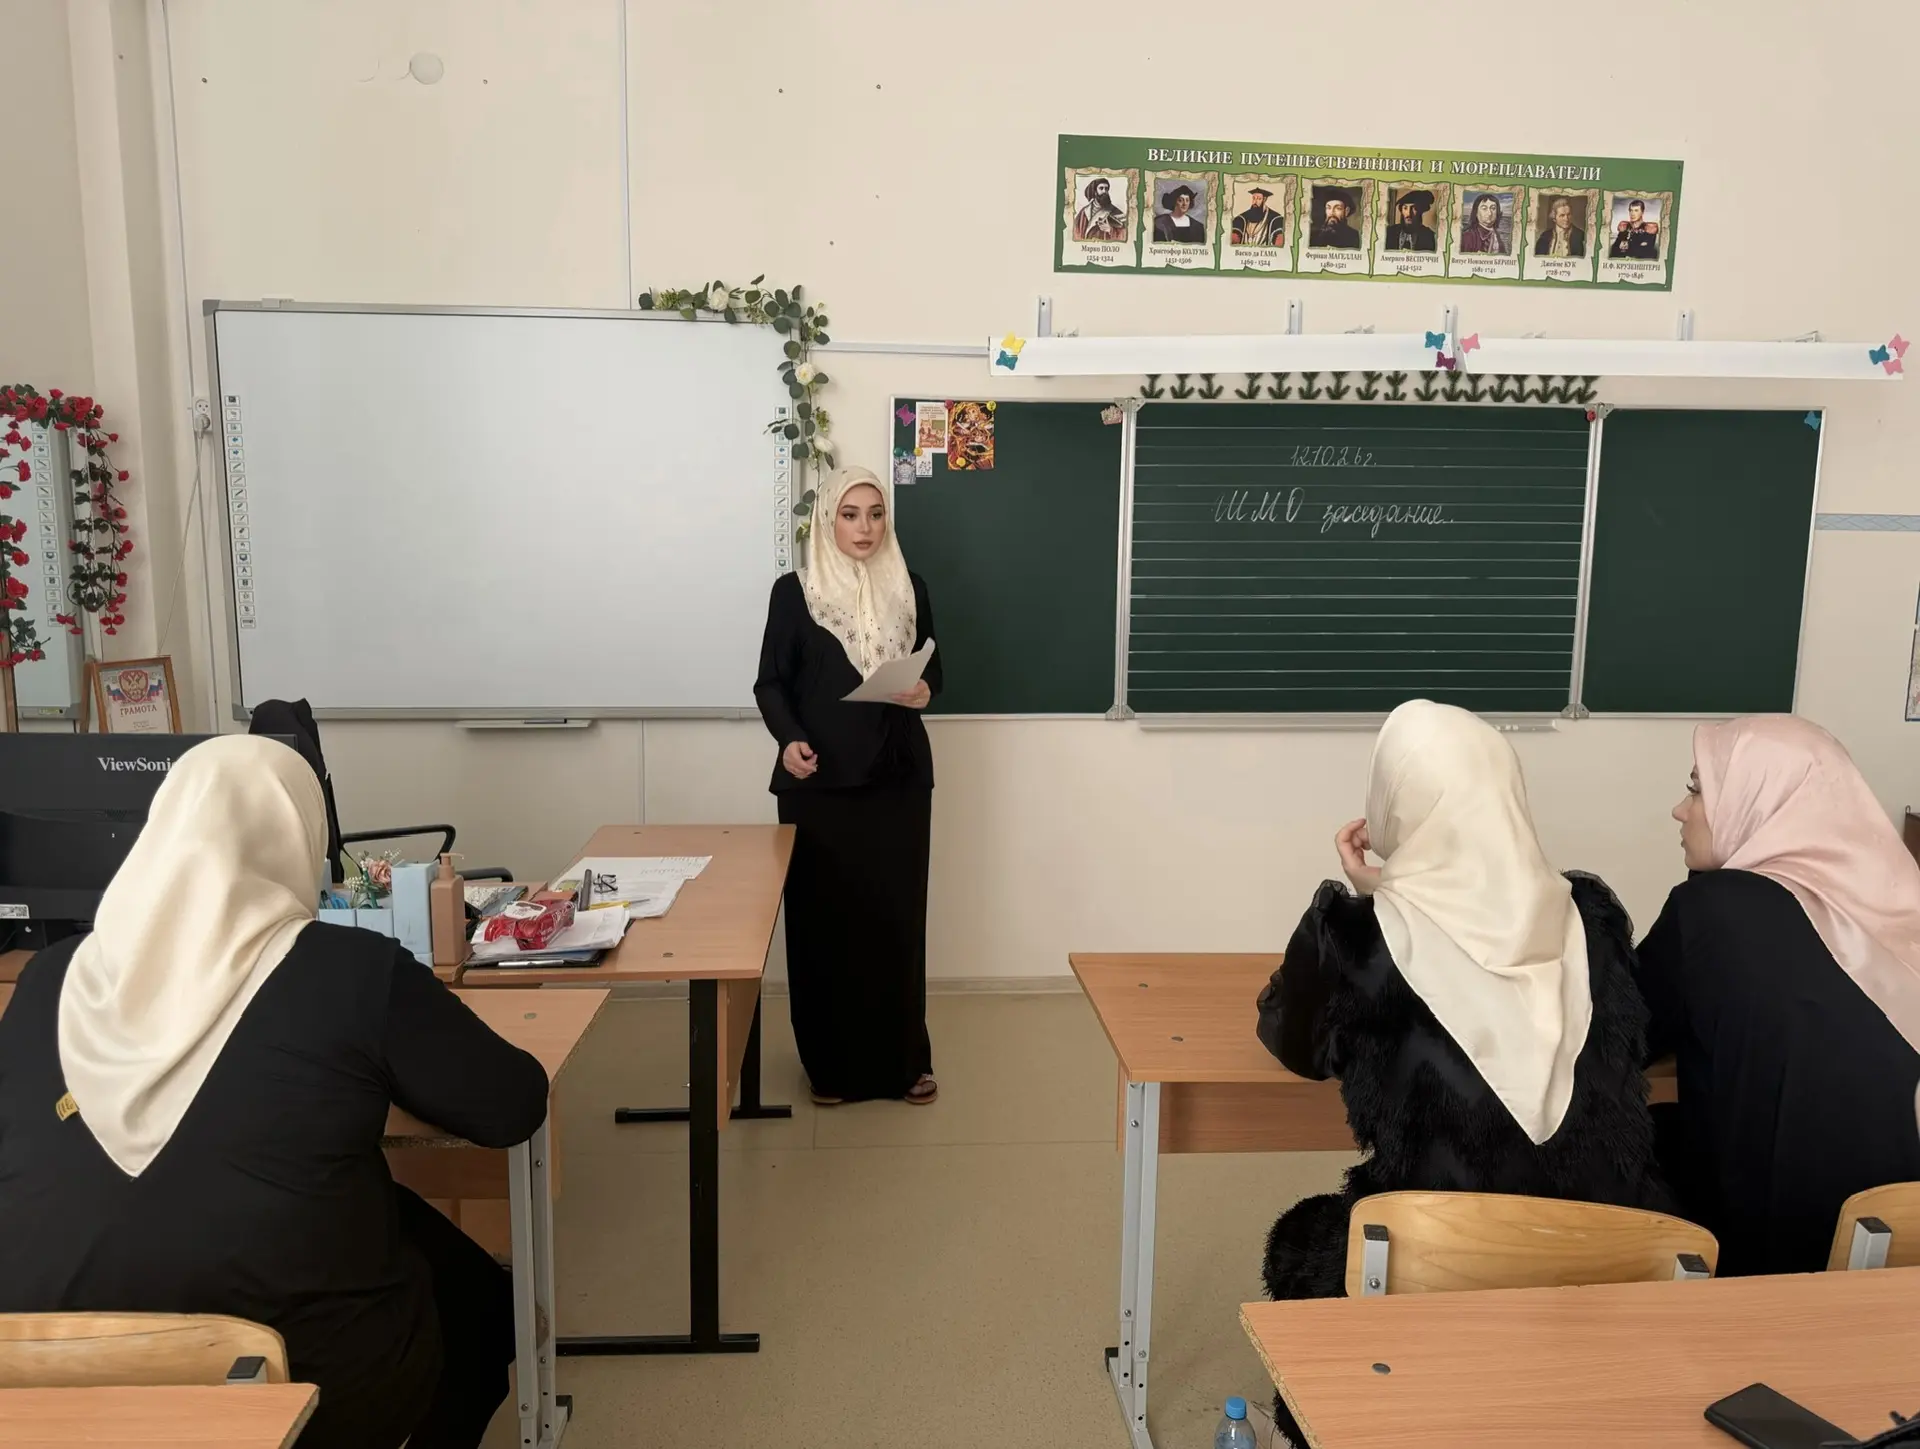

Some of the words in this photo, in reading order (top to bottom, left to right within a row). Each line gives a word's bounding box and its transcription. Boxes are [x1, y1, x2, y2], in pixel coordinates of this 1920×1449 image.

[1147, 148, 1233, 165] ВЕЛИКИЕ
[1240, 152, 1423, 173] ПУТЕШЕСТВЕННИКИ
[1429, 160, 1445, 173] И
[1451, 160, 1602, 181] МОРЕПЛАВАТЕЛИ
[1081, 245, 1101, 254] Марко
[1101, 245, 1120, 253] ПОЛО
[1149, 247, 1181, 257] Христофор
[1234, 249, 1252, 257] Васко
[1328, 253, 1362, 261] МАГЕЛЛАН
[1406, 255, 1439, 263] ВЕСПУЧЧИ
[120, 704, 158, 717] ГРАМОТА
[97, 757, 172, 772] ViewSoni
